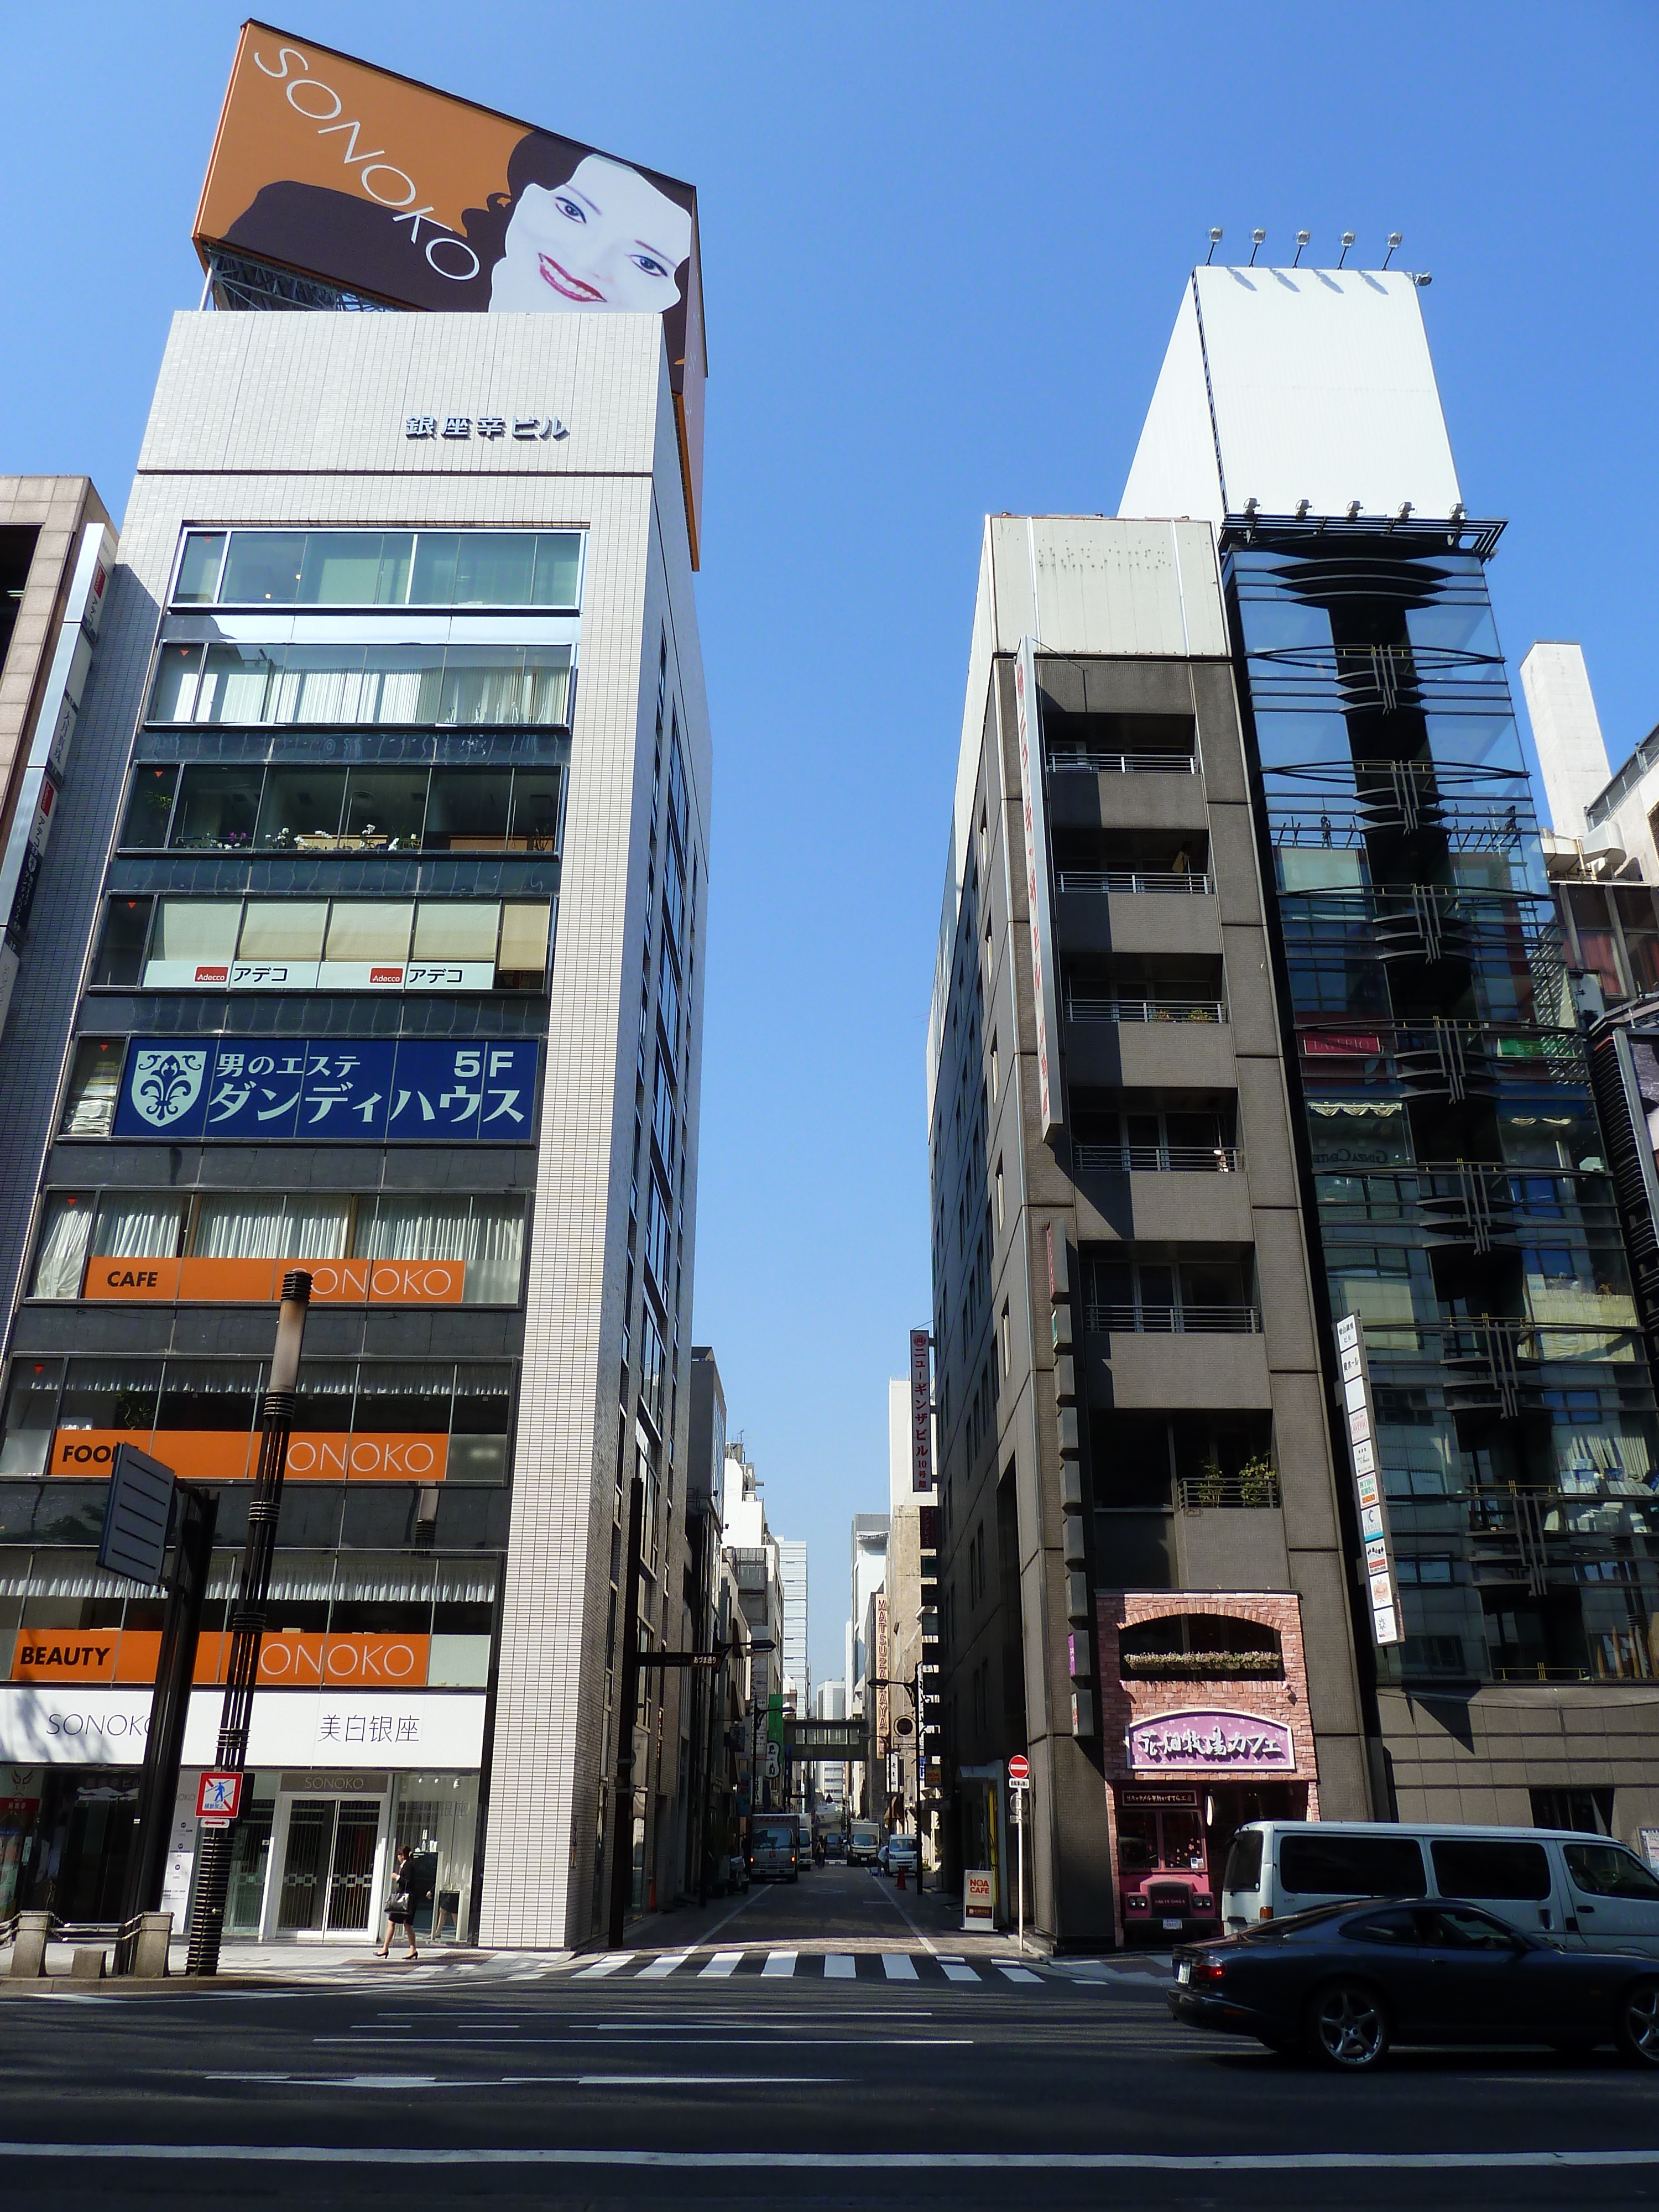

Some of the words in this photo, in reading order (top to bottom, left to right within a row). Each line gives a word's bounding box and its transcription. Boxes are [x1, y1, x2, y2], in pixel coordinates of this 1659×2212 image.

[254, 47, 480, 281] SONOKO
[405, 415, 571, 440] 銀座幸ビル
[198, 973, 226, 983] Adecco
[234, 968, 288, 983] アデコ
[373, 974, 400, 983] Adecco
[409, 969, 463, 984] アデコ
[216, 1053, 361, 1076] 男のエステ
[454, 1051, 514, 1078] 5F
[209, 1081, 525, 1124] ダンディハウス
[107, 1271, 158, 1288] CAFE
[293, 1267, 452, 1296] ONOKO
[62, 1444, 135, 1463] FOO
[288, 1442, 435, 1473] ONOKO
[20, 1647, 110, 1666] BEAUTY
[260, 1642, 415, 1677] ONOKO
[693, 1656, 717, 1664] あづま通り
[304, 1777, 364, 1790] SONOKO
[969, 1879, 989, 1887] NOA
